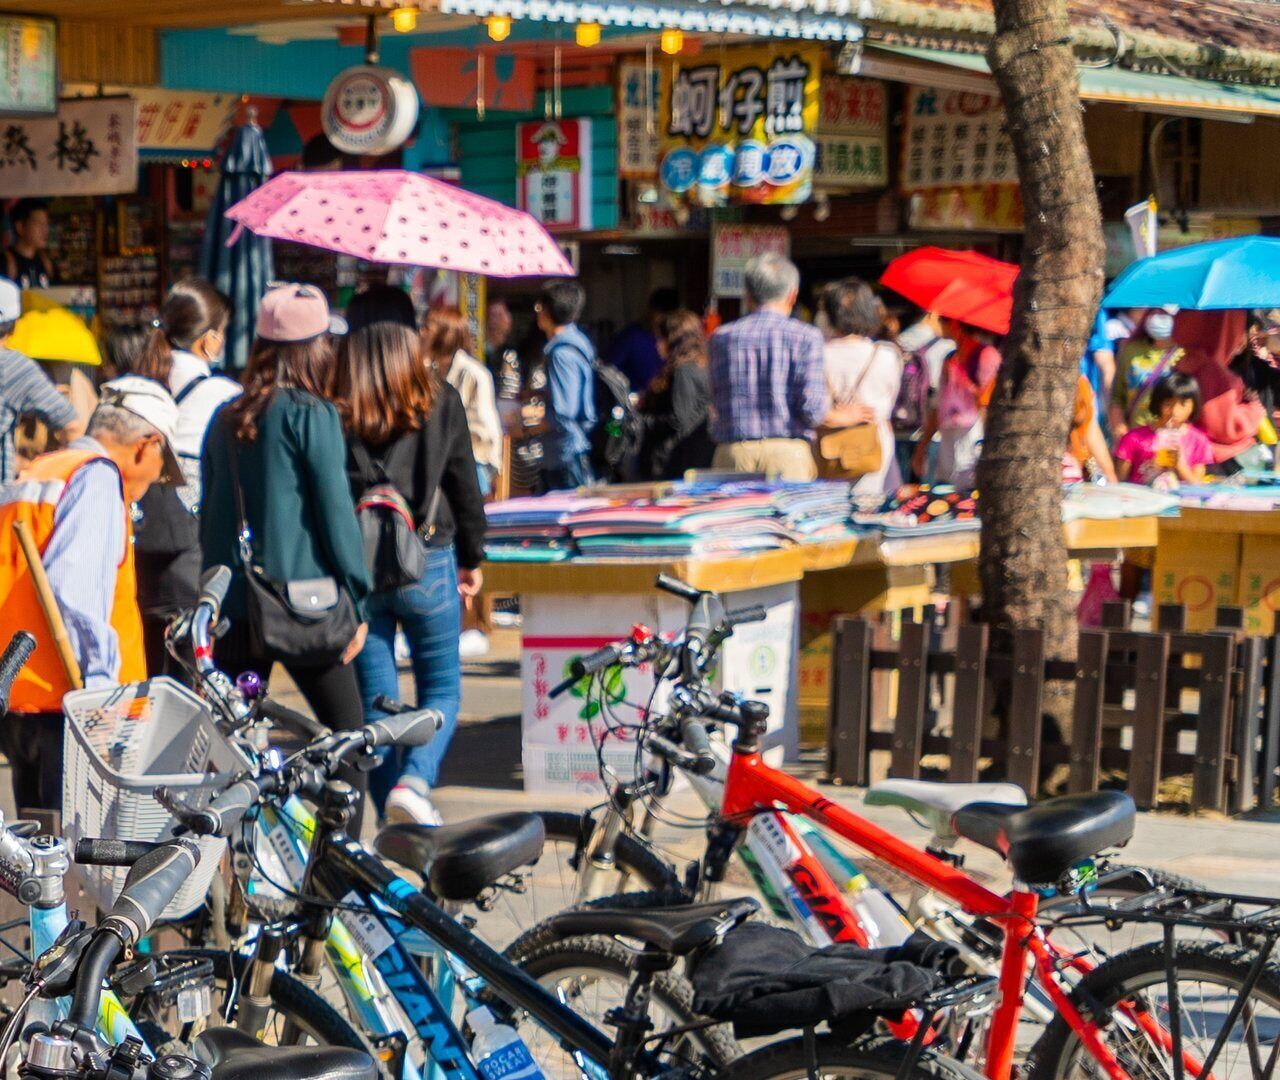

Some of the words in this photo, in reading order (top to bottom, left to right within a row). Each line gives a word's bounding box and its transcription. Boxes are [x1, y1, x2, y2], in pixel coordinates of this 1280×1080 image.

[667, 57, 809, 140] 蚵仔煎
[785, 864, 846, 945] GIA
